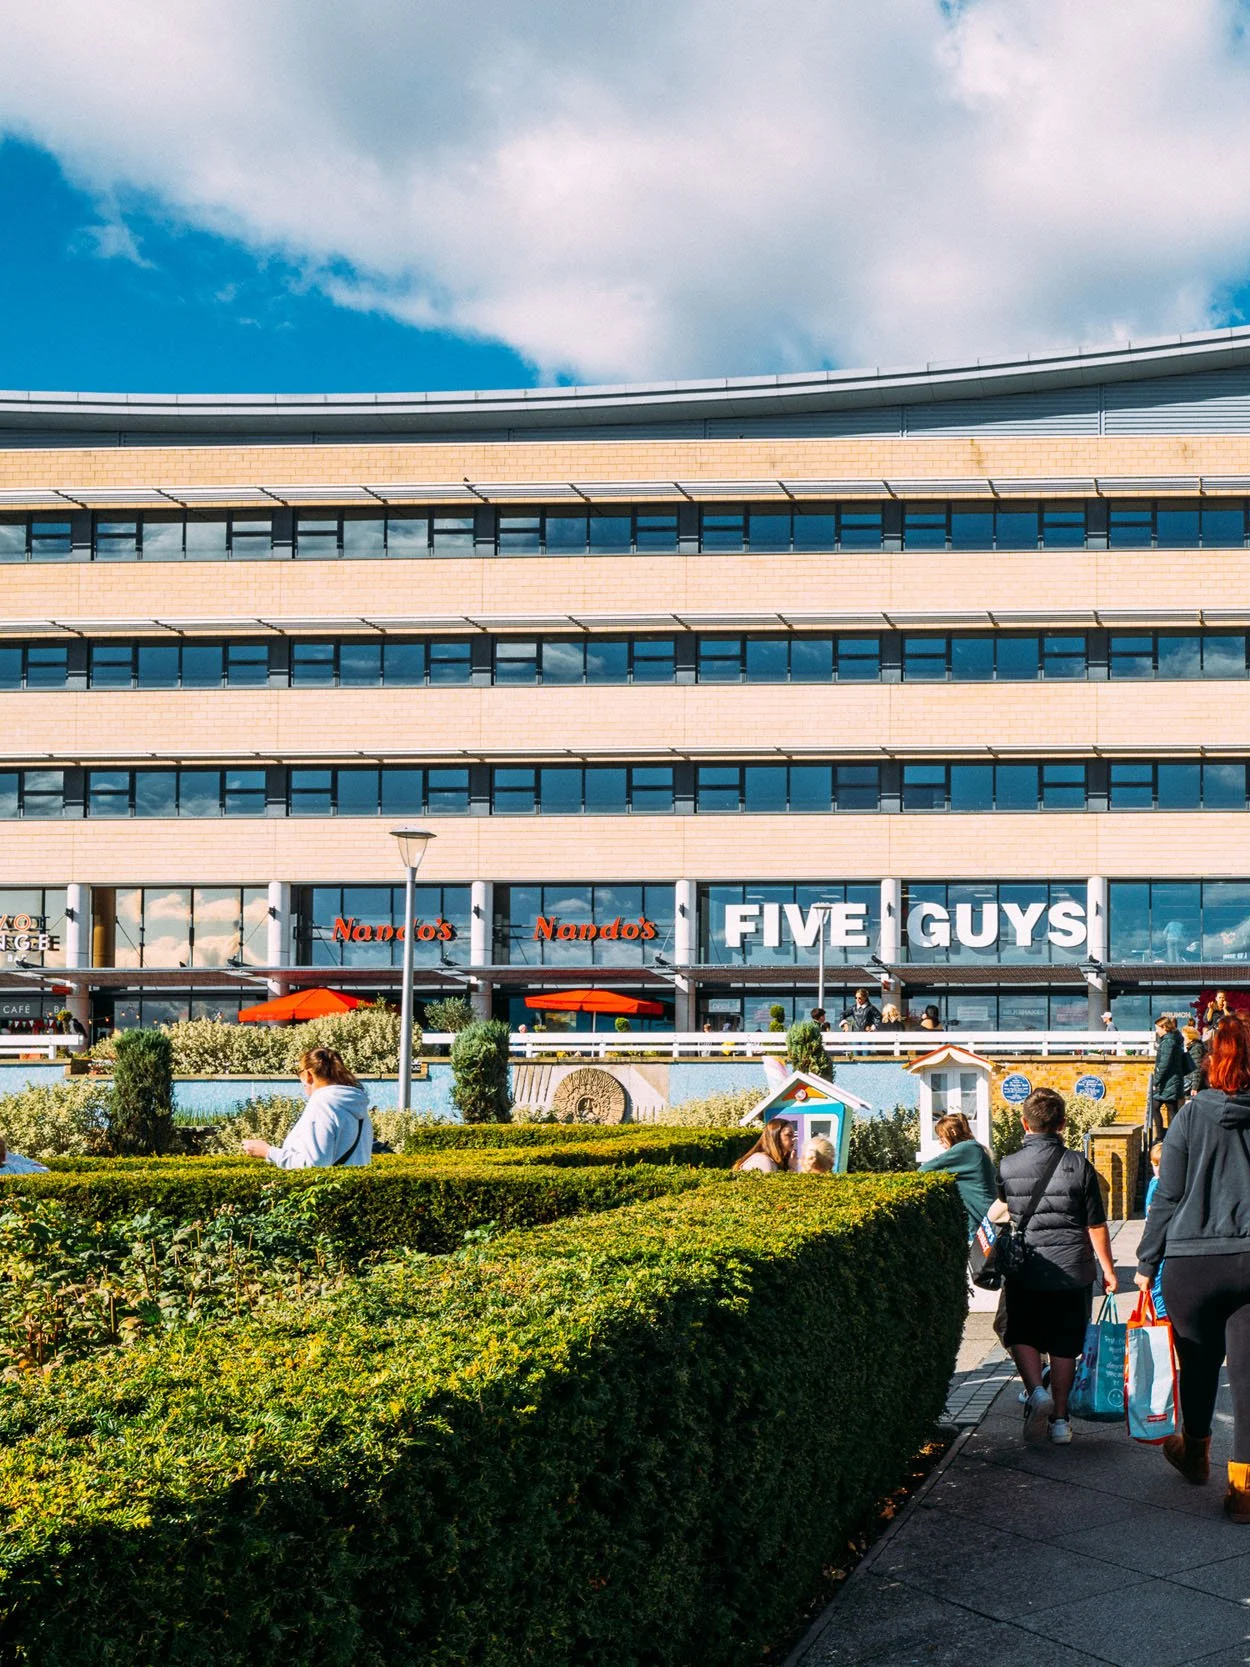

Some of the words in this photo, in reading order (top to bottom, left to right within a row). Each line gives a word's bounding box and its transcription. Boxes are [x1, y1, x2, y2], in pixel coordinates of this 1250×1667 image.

[533, 916, 656, 940] Nando's
[724, 903, 868, 948] FIVE
[906, 902, 1089, 949] GUYS
